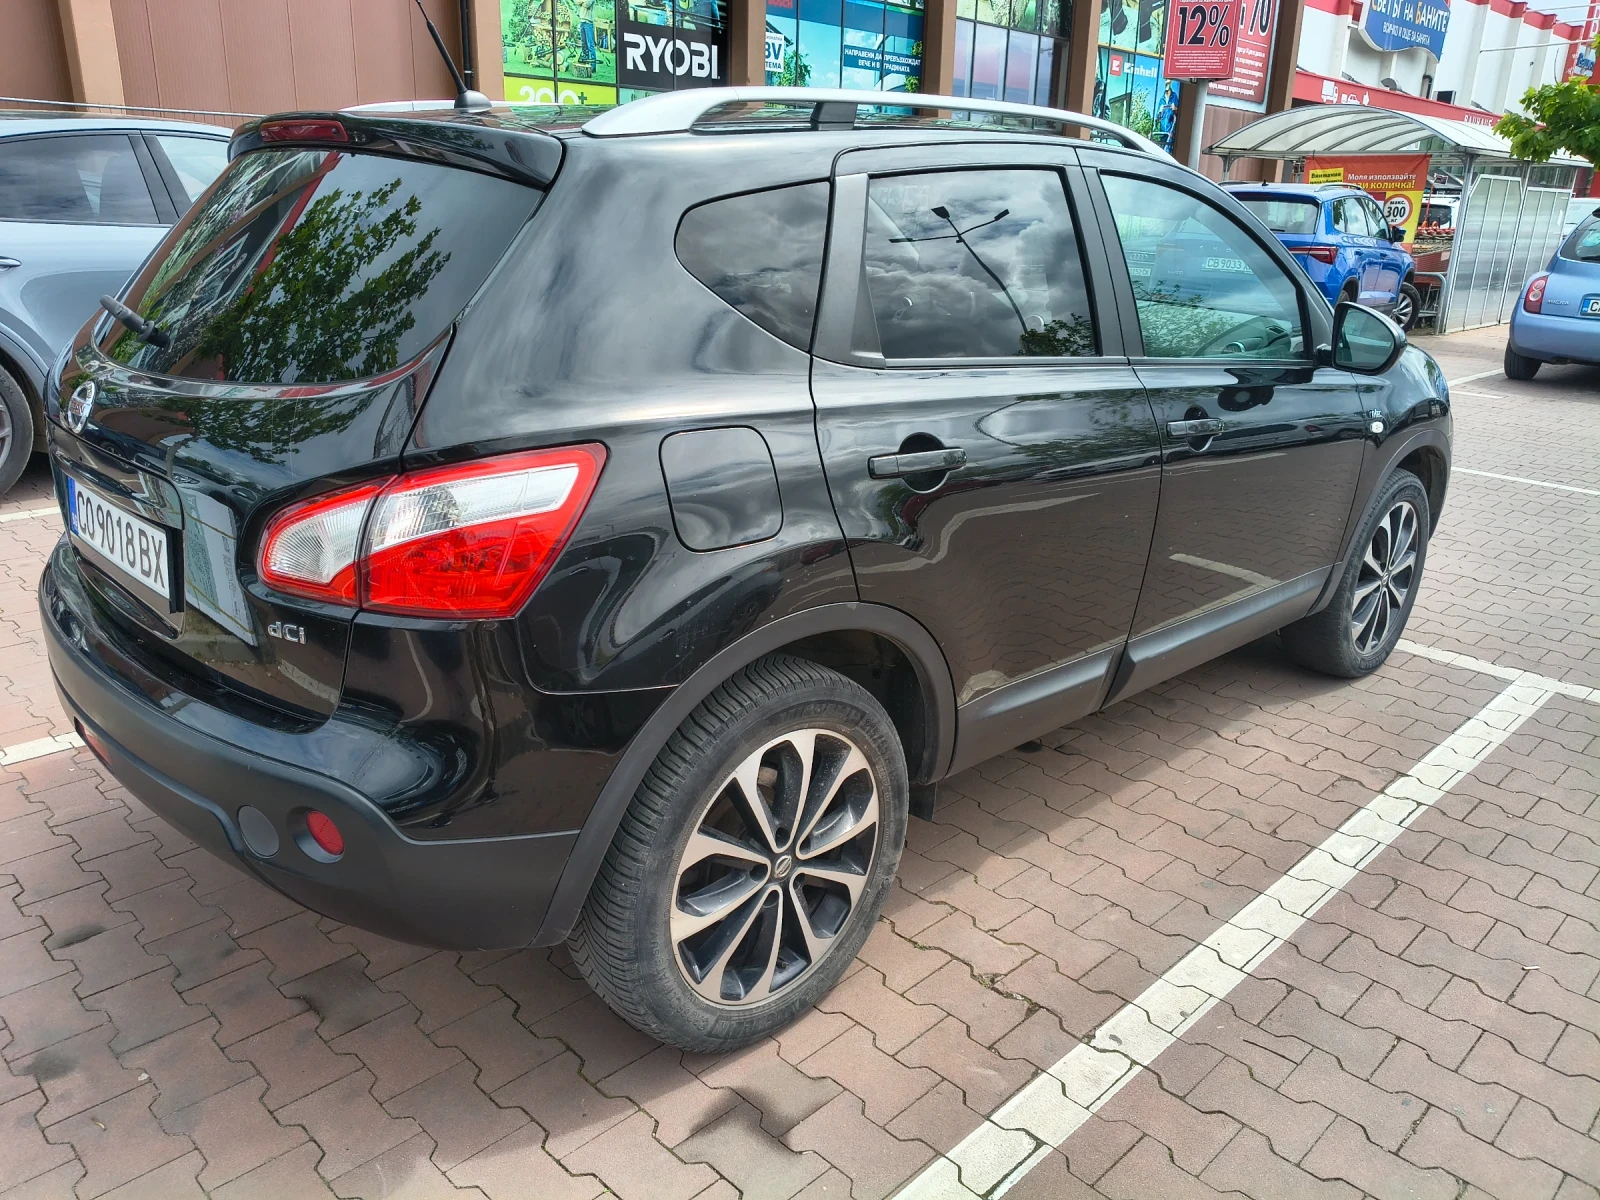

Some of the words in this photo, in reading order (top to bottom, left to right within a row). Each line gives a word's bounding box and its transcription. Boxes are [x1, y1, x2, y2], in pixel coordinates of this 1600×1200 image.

[1403, 3, 1414, 22] НА
[1178, 4, 1230, 47] 12%
[623, 32, 719, 79] RYOBI
[844, 48, 874, 59] НАПРАВЕНИ
[874, 52, 882, 62] ДА
[884, 62, 910, 72] ГРАДИНАТА
[1124, 62, 1157, 78] Einhell
[1370, 180, 1415, 189] количка!
[1386, 206, 1406, 218] 300
[1208, 258, 1219, 268] CB
[1221, 260, 1242, 269] 9033
[1590, 301, 1600, 312] C
[77, 490, 95, 540] CO
[96, 504, 136, 568] 9018
[138, 528, 166, 589] BX
[268, 621, 306, 644] dCi
